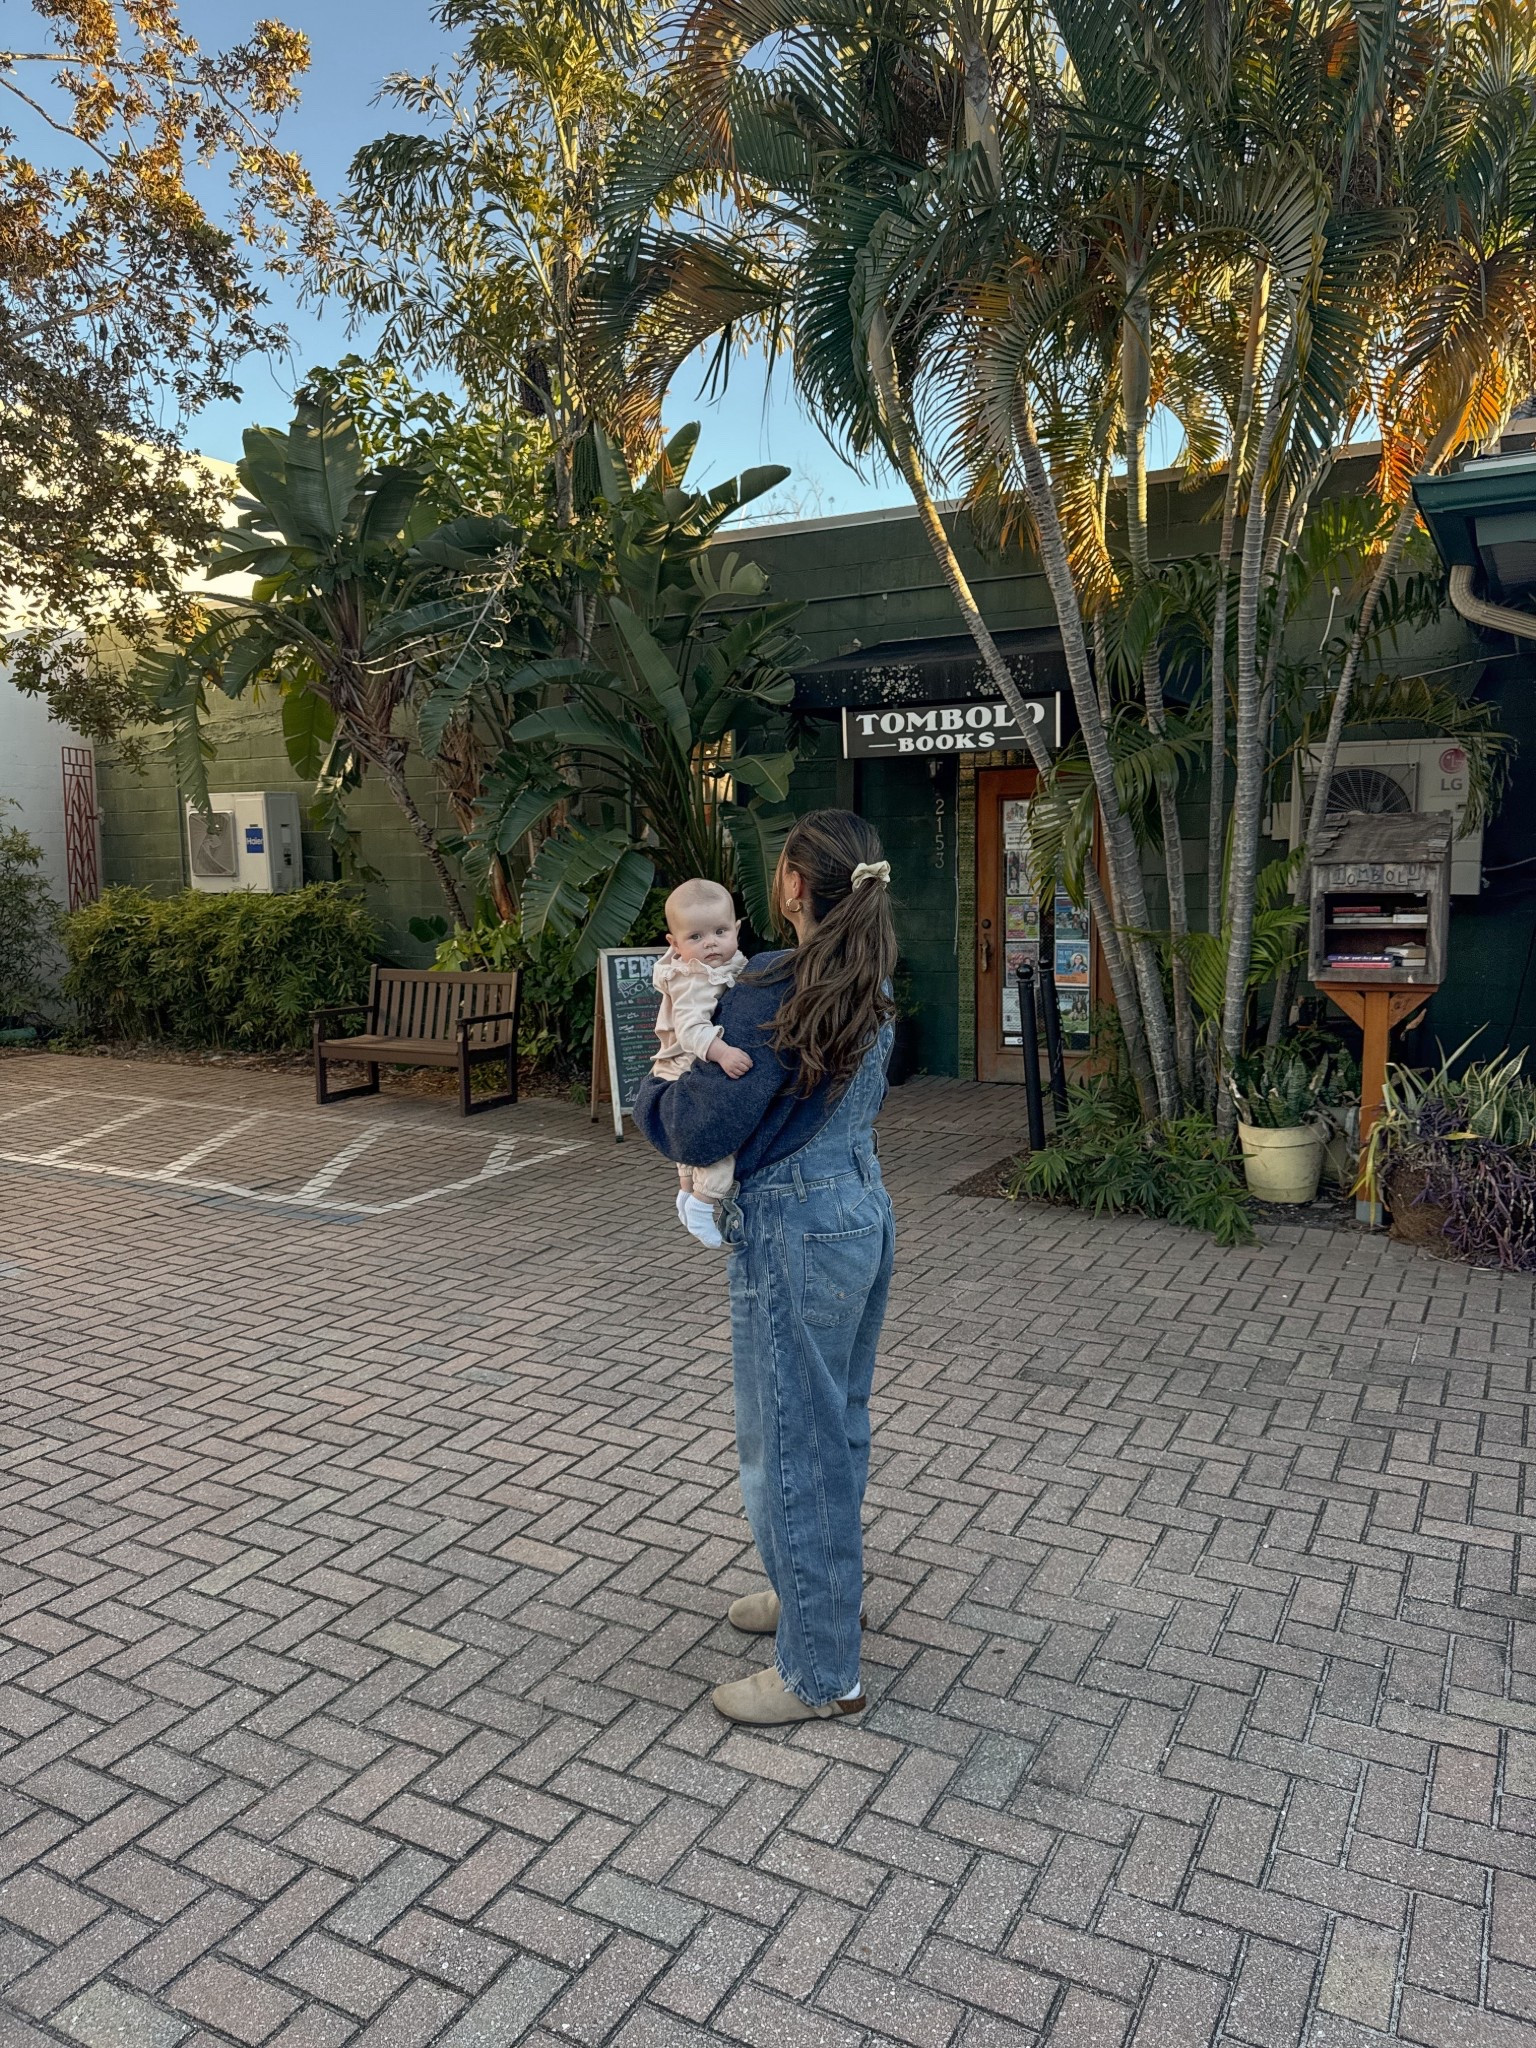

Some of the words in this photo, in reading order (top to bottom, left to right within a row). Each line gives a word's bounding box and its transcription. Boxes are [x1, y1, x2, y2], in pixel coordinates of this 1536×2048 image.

[856, 702, 1045, 736] TOMBOLO
[898, 731, 996, 752] BOOKS
[1440, 778, 1463, 791] LG
[246, 836, 264, 846] Haier
[934, 799, 946, 869] 2153
